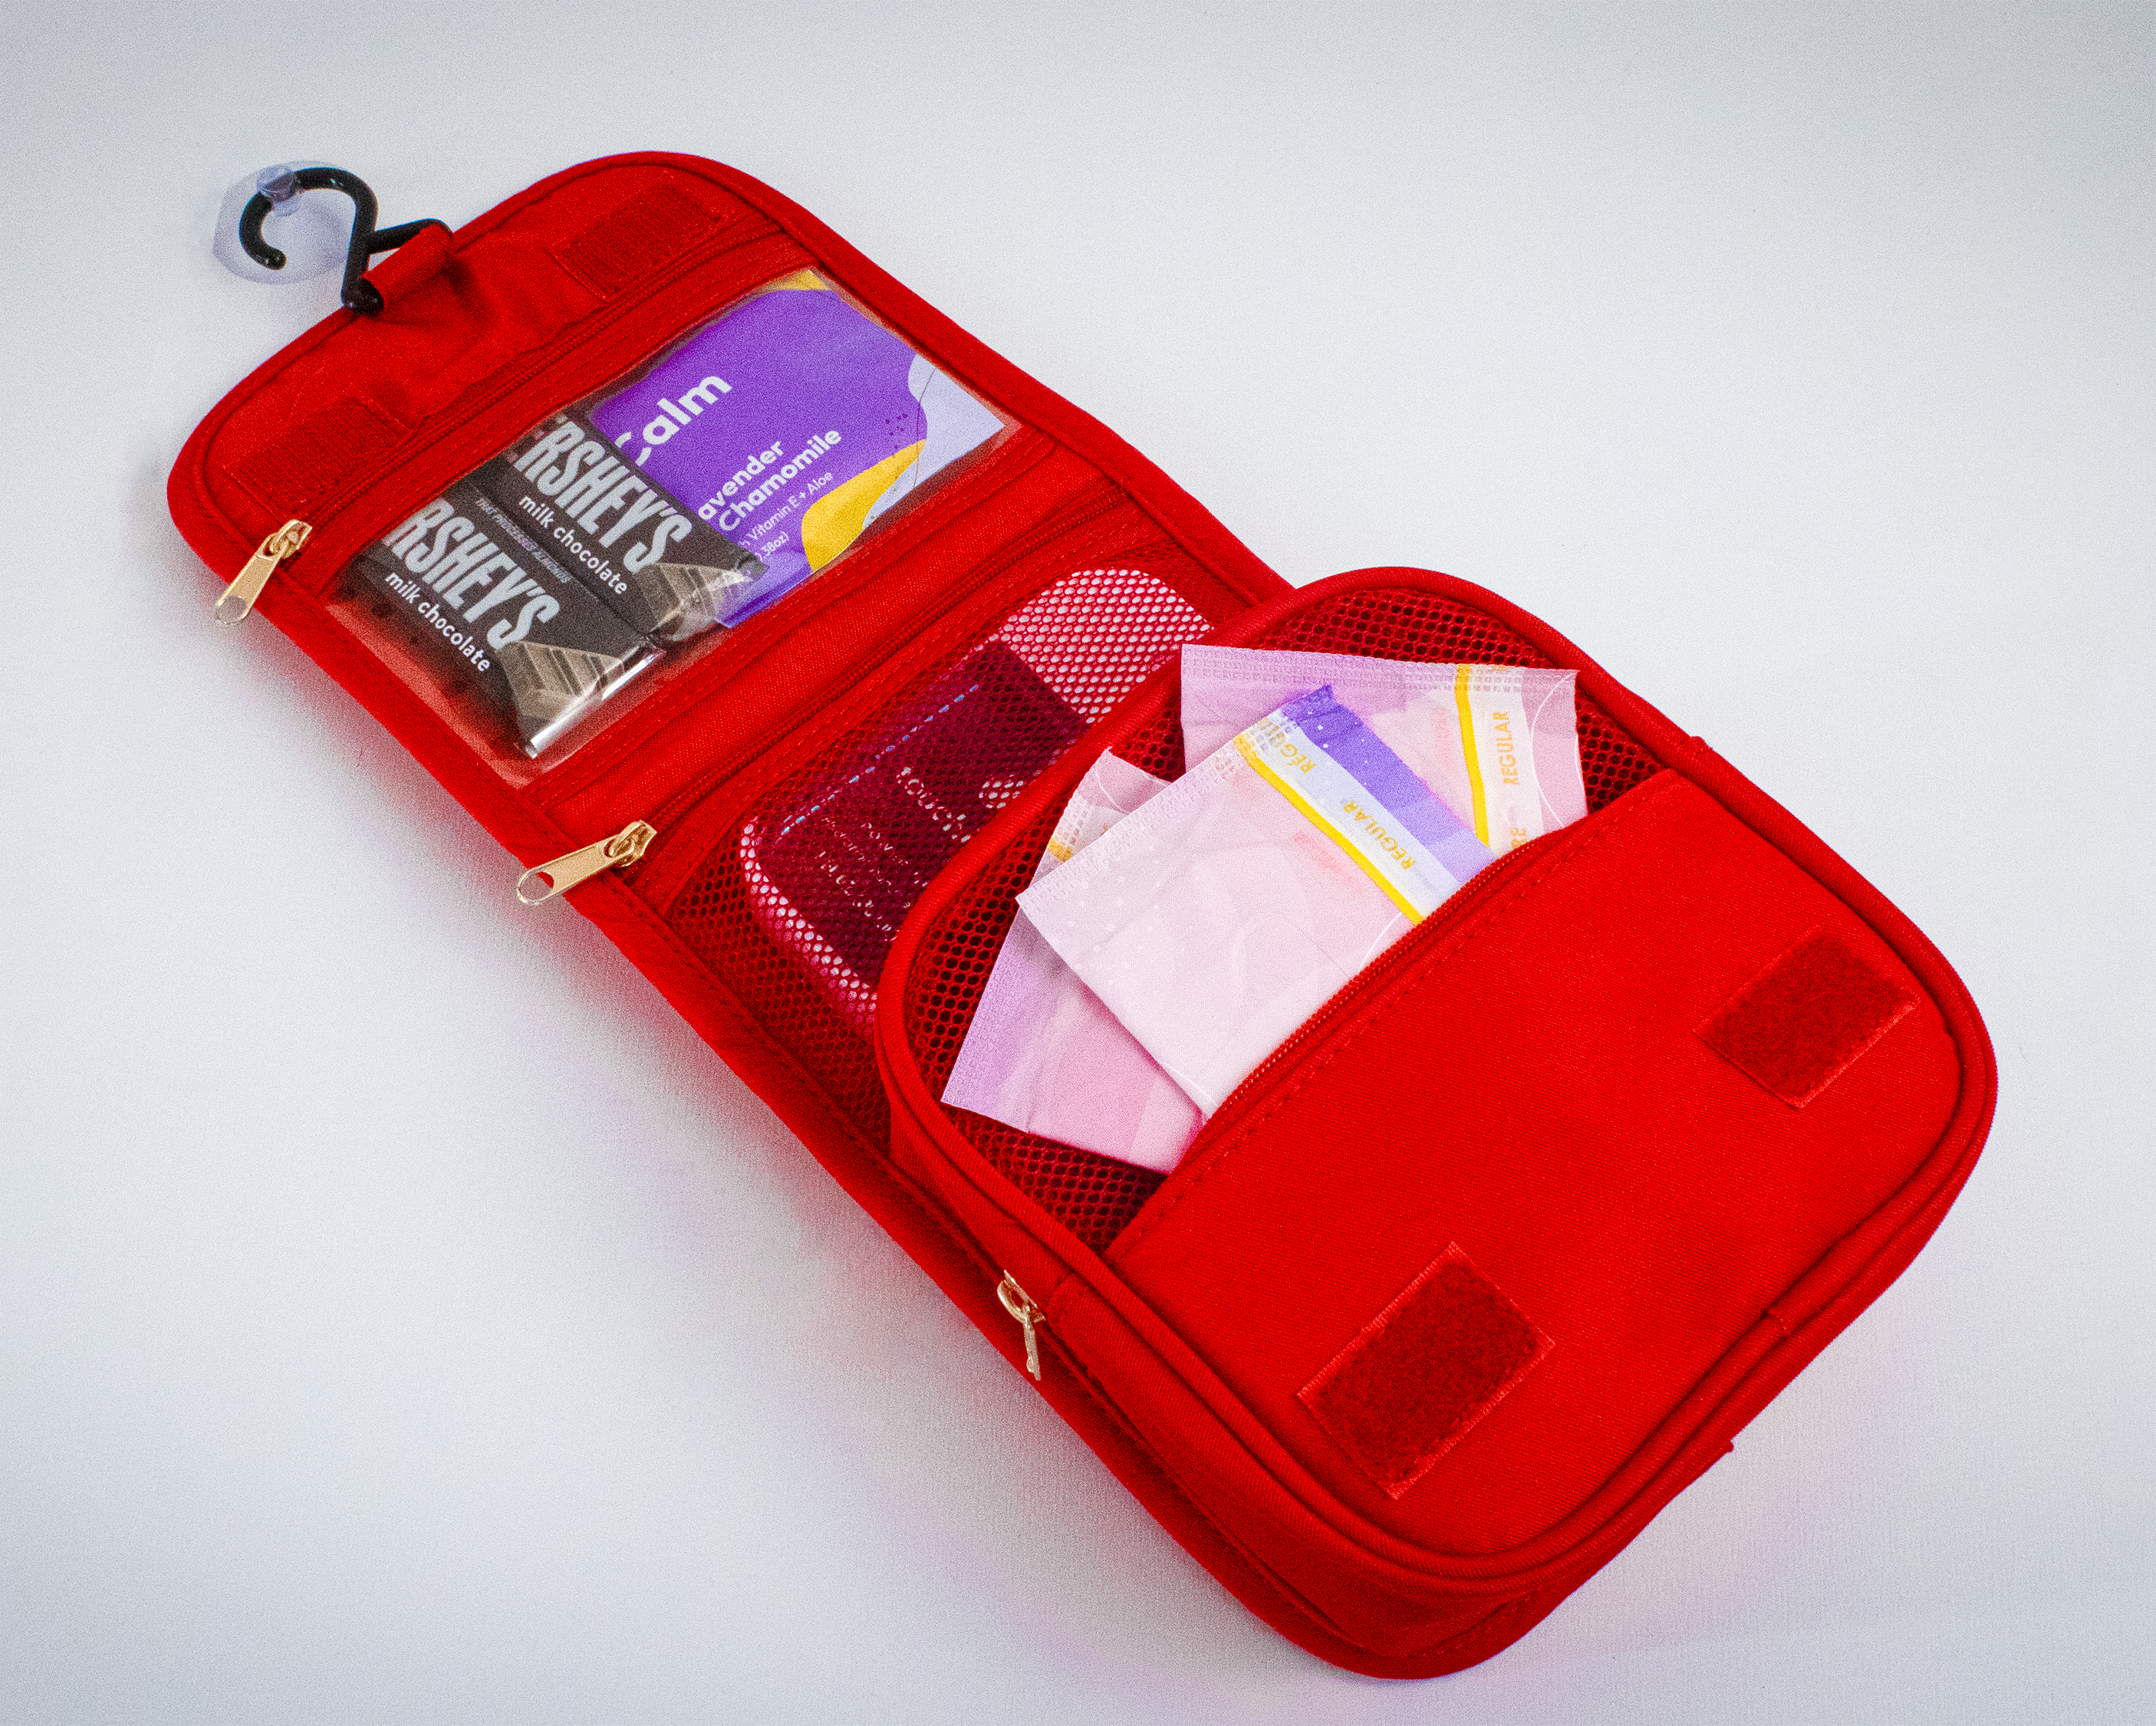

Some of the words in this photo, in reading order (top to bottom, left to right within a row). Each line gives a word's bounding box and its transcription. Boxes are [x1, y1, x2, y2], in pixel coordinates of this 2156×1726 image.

[509, 417, 693, 573] RSHEY'S
[719, 428, 841, 531] Chamomile
[746, 506, 792, 539] Vitamin
[788, 495, 801, 508] E
[807, 472, 833, 495] Aloe
[519, 496, 554, 528] milk
[554, 527, 627, 593] chocolate
[385, 573, 420, 605] milk
[418, 599, 490, 672] chocolate
[1493, 712, 1519, 785] REGULAR
[1344, 801, 1416, 870] REGULAR
